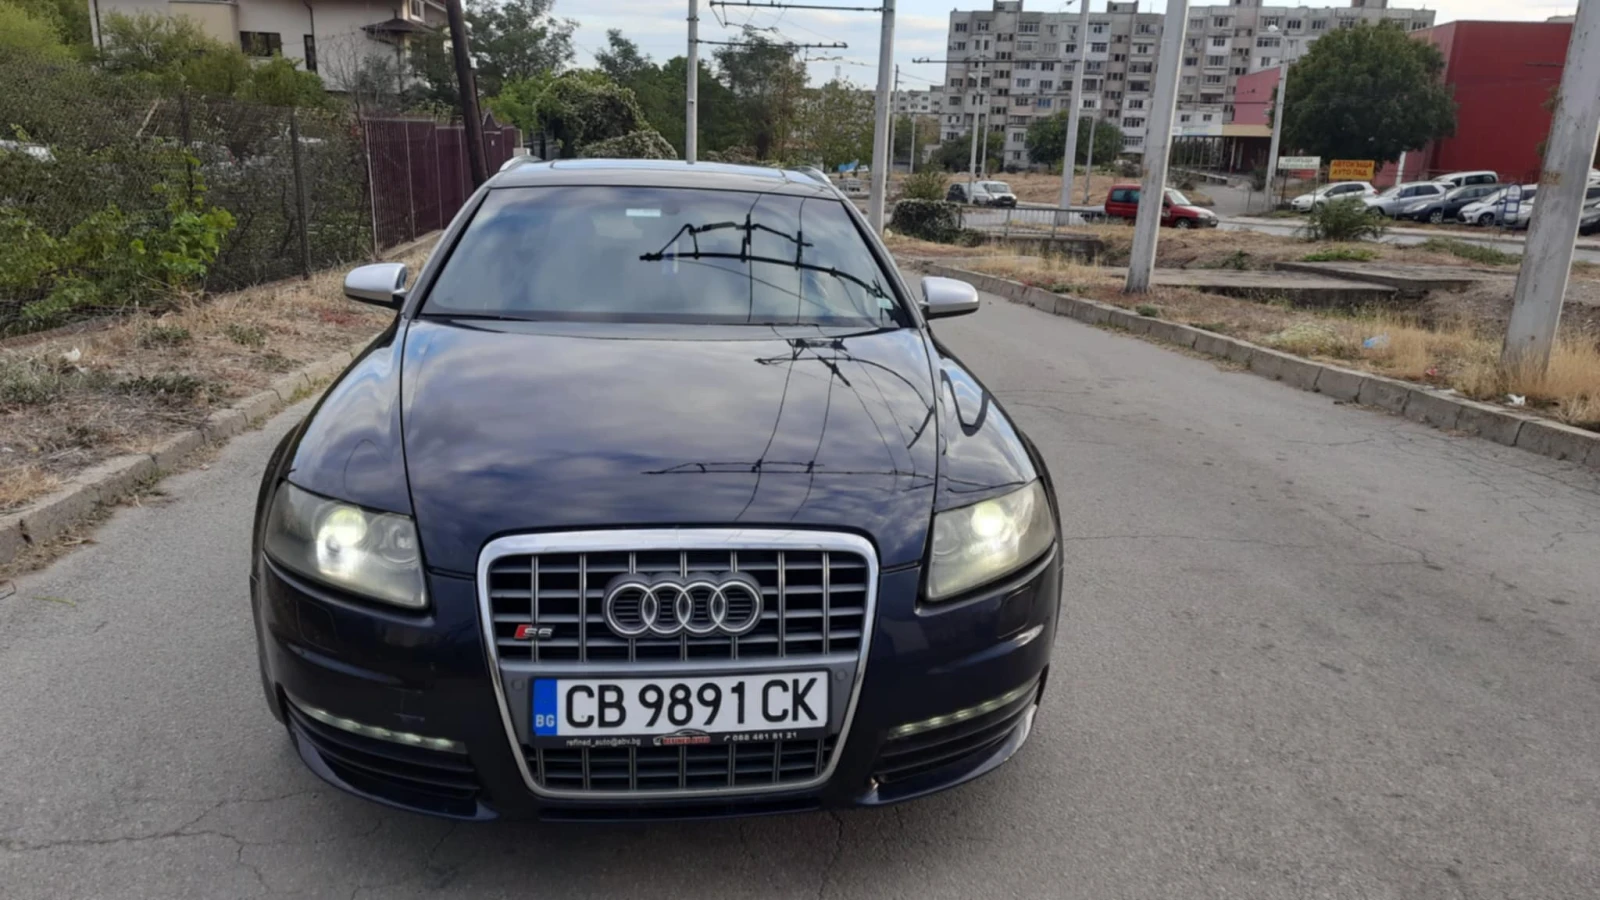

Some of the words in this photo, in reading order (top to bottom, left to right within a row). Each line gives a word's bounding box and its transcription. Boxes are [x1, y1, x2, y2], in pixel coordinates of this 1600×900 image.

[565, 684, 627, 729] CB
[638, 680, 745, 727] 9891
[761, 677, 818, 723] CK
[535, 714, 555, 728] BG
